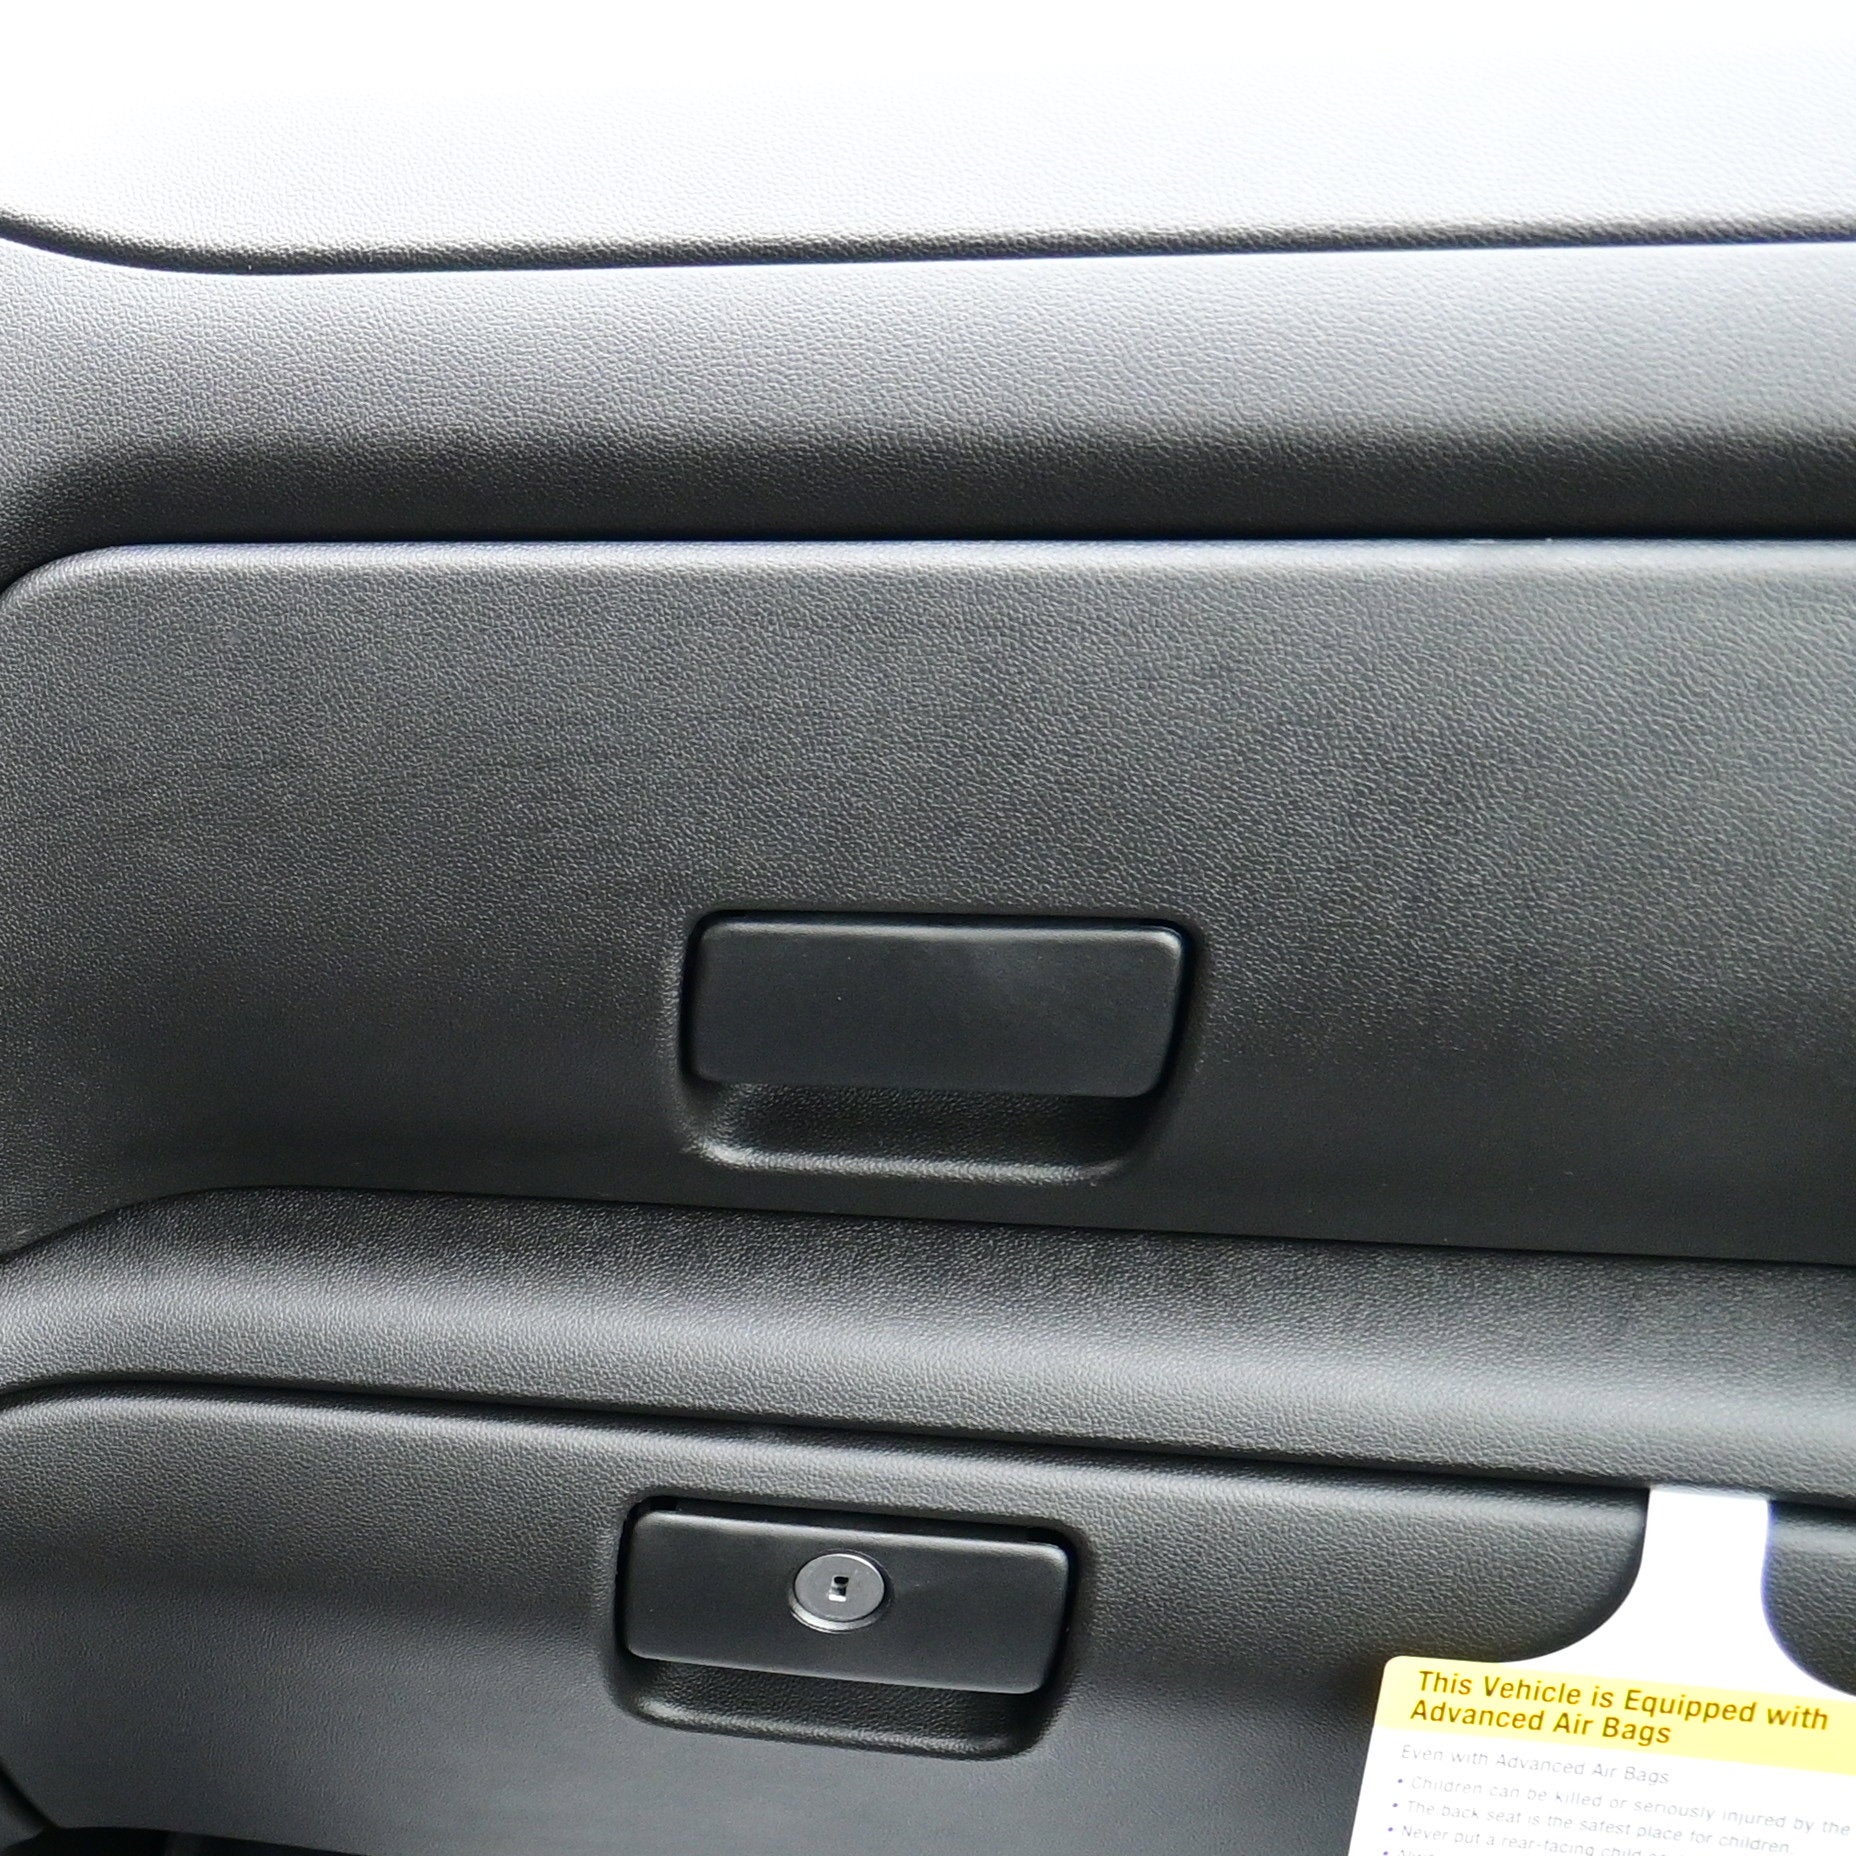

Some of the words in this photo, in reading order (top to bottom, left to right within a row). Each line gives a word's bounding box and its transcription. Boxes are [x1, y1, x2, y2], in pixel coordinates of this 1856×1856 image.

[1411, 1699, 1543, 1733] Advanced
[1553, 1713, 1593, 1738] Air
[1603, 1717, 1671, 1746] Bags
[1418, 1670, 1472, 1696] This
[1484, 1675, 1581, 1706] Vehicle
[1592, 1687, 1613, 1708] is
[1624, 1689, 1756, 1724] Equipped
[1767, 1705, 1829, 1731] with
[1401, 1744, 1443, 1760] Even
[1451, 1751, 1488, 1765] with
[1496, 1753, 1585, 1775] Advanced
[1591, 1763, 1616, 1778] Air
[1625, 1766, 1670, 1786] Bags
[1411, 1776, 1482, 1794] Children
[1634, 1800, 1715, 1821] seriously
[1793, 1817, 1815, 1833] by
[1822, 1821, 1850, 1836] the
[1636, 1825, 1682, 1841] place
